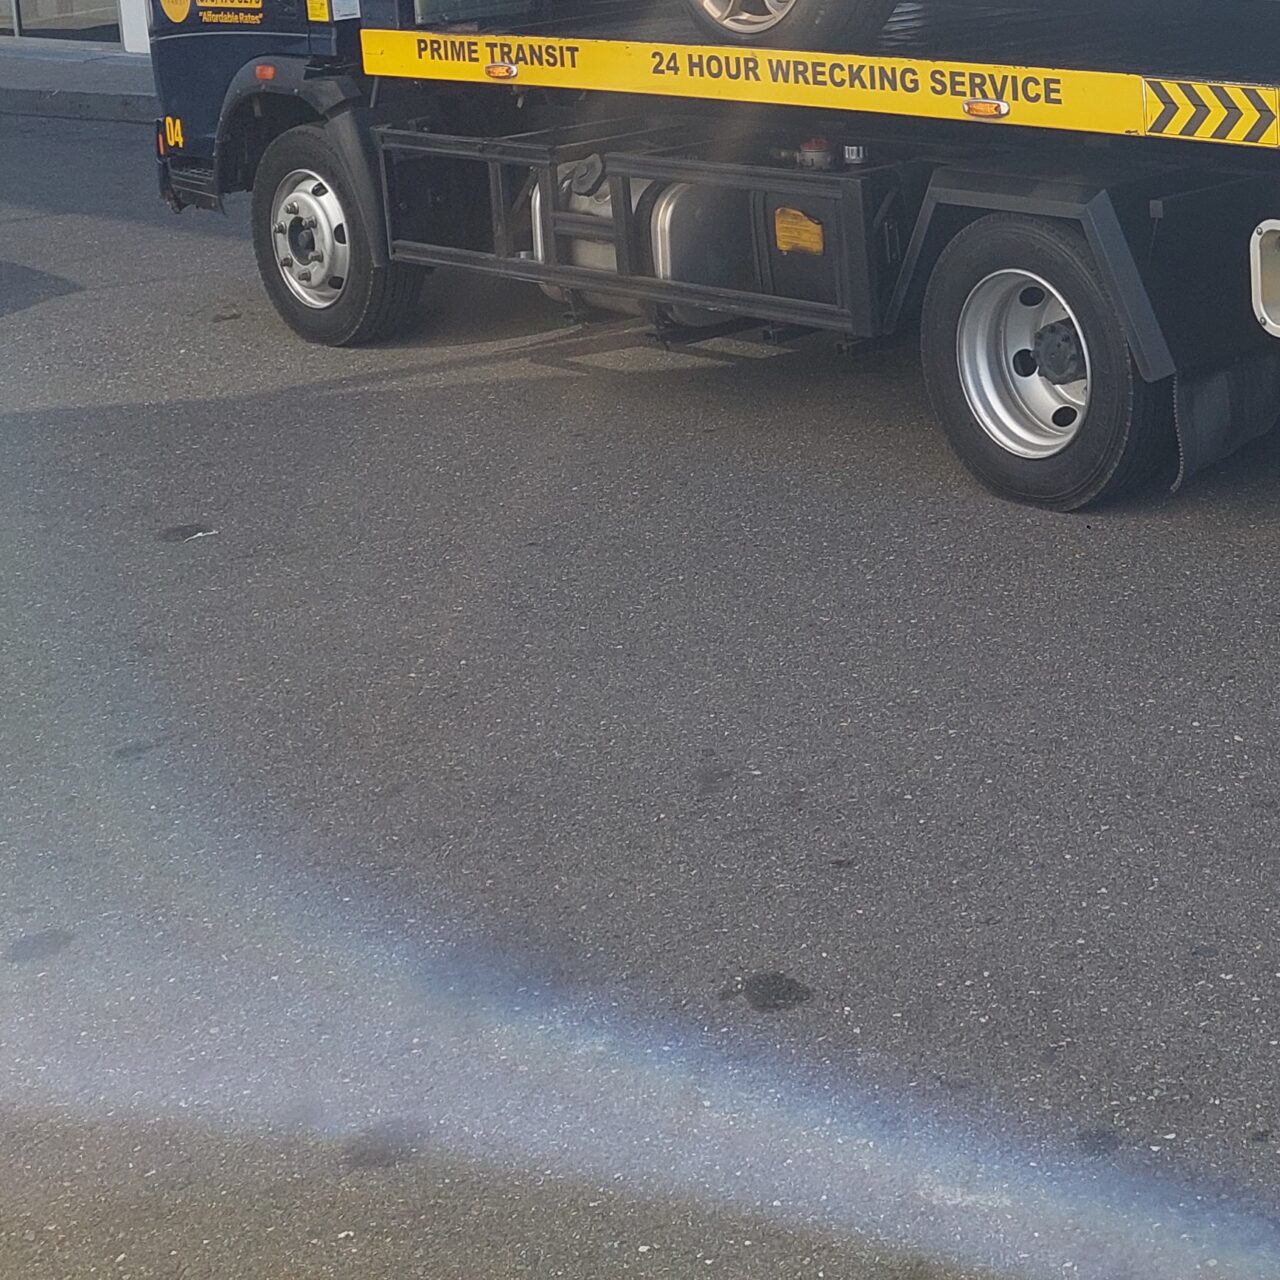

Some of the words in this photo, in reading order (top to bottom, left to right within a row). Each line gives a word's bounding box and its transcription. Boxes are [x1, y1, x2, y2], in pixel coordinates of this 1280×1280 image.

[417, 39, 479, 63] PRIME
[485, 42, 579, 68] TRANSIT
[651, 51, 680, 76] 24
[687, 53, 761, 82] HOUR
[768, 58, 919, 93] WRECKING
[930, 69, 1062, 105] SERVICE
[165, 116, 184, 148] 04
